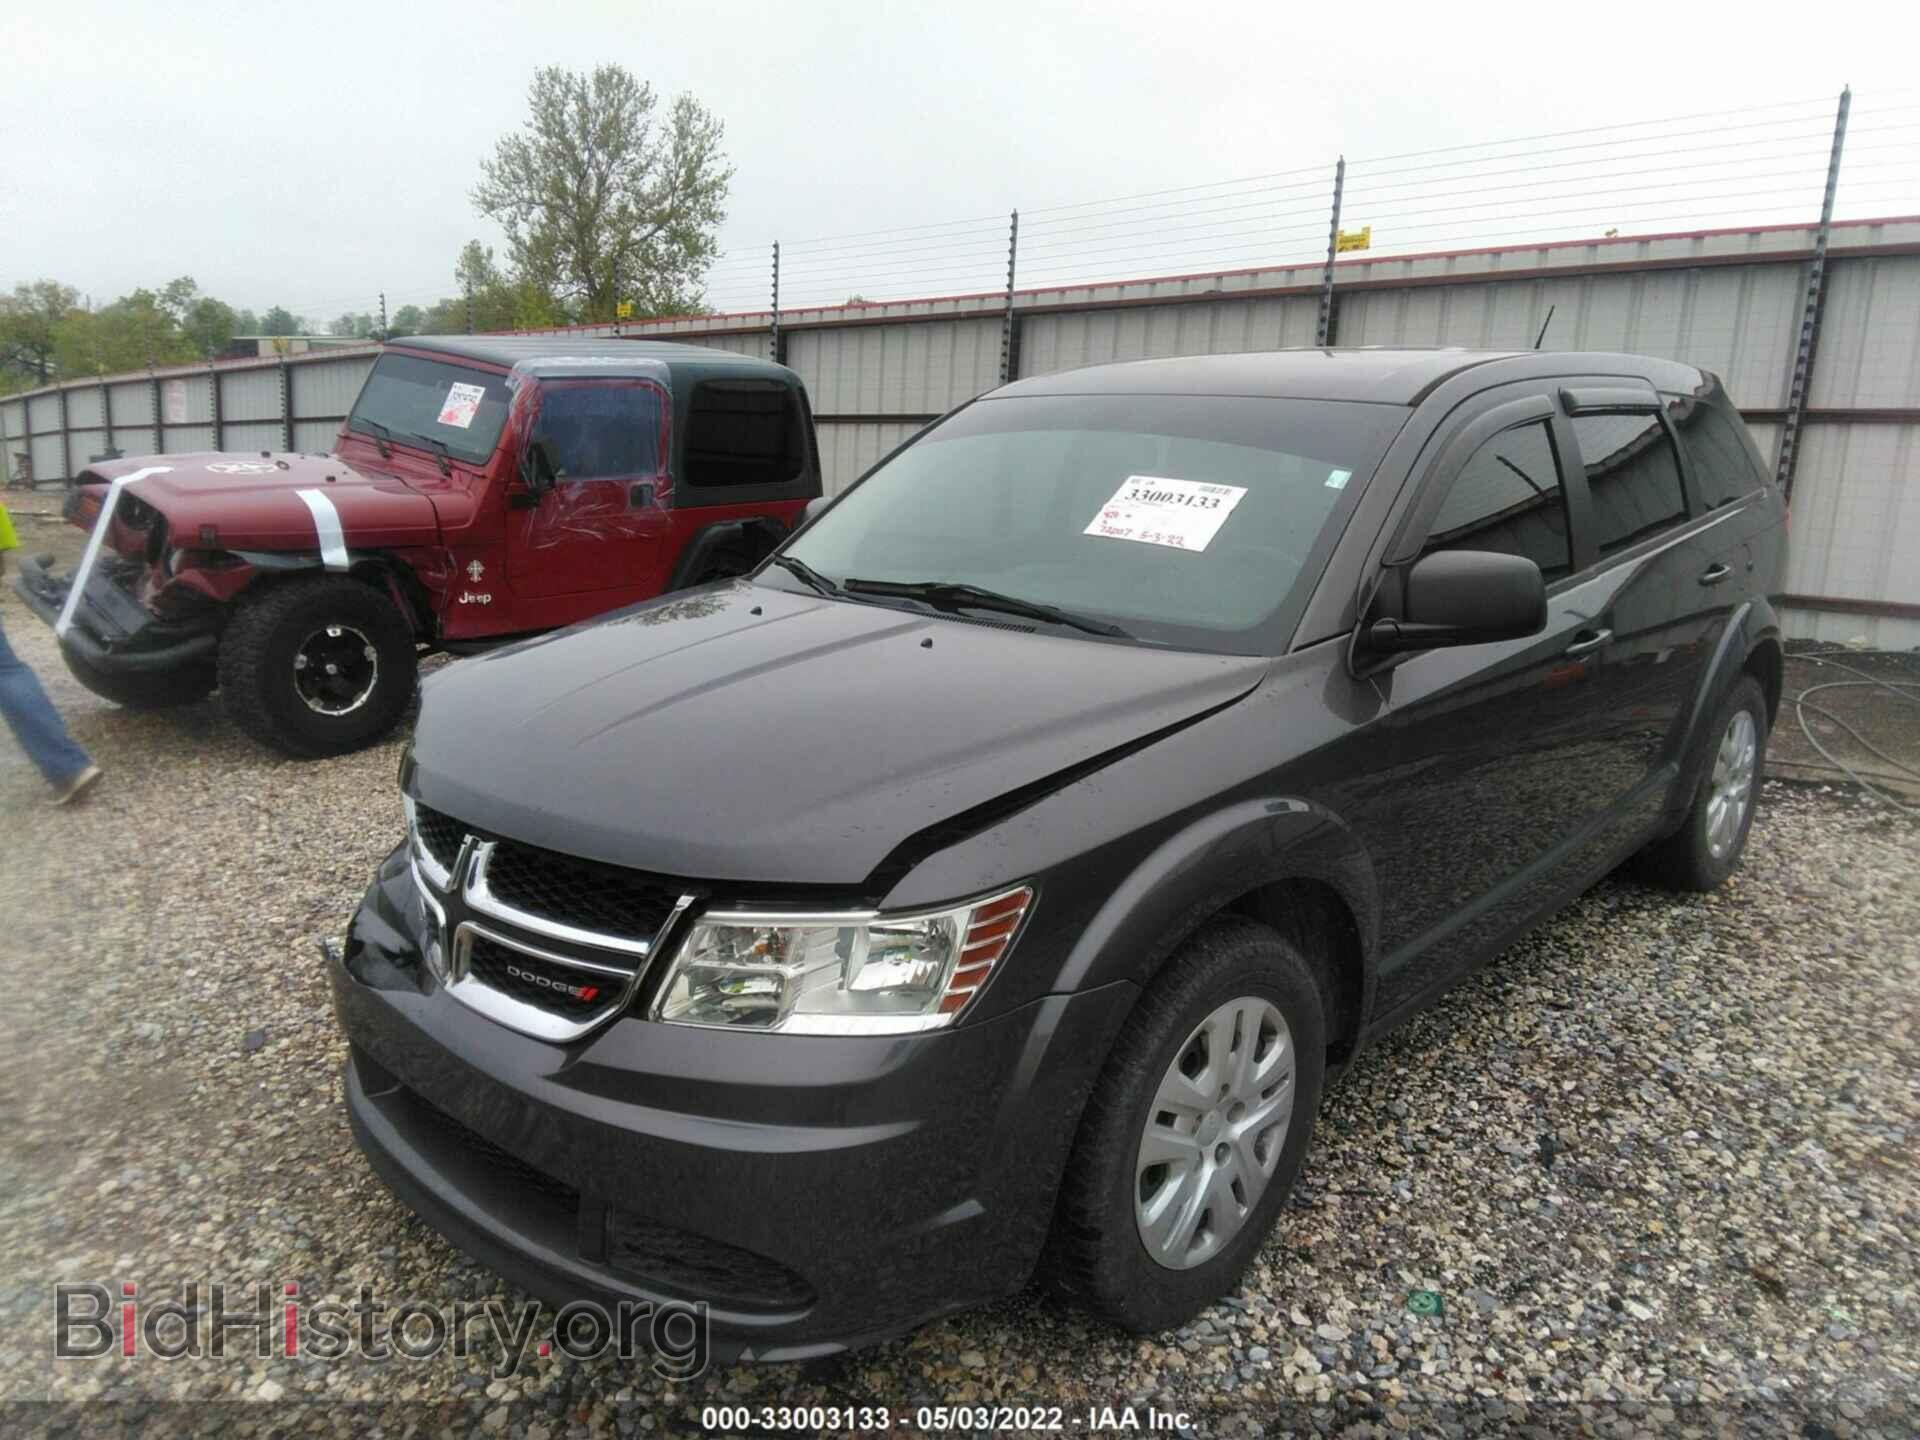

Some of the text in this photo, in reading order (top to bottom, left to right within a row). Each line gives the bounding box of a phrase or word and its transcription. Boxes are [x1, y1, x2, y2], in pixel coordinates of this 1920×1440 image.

[1124, 489, 1221, 509] 33003133
[458, 591, 492, 605] Jeep
[507, 965, 578, 996] DODGE
